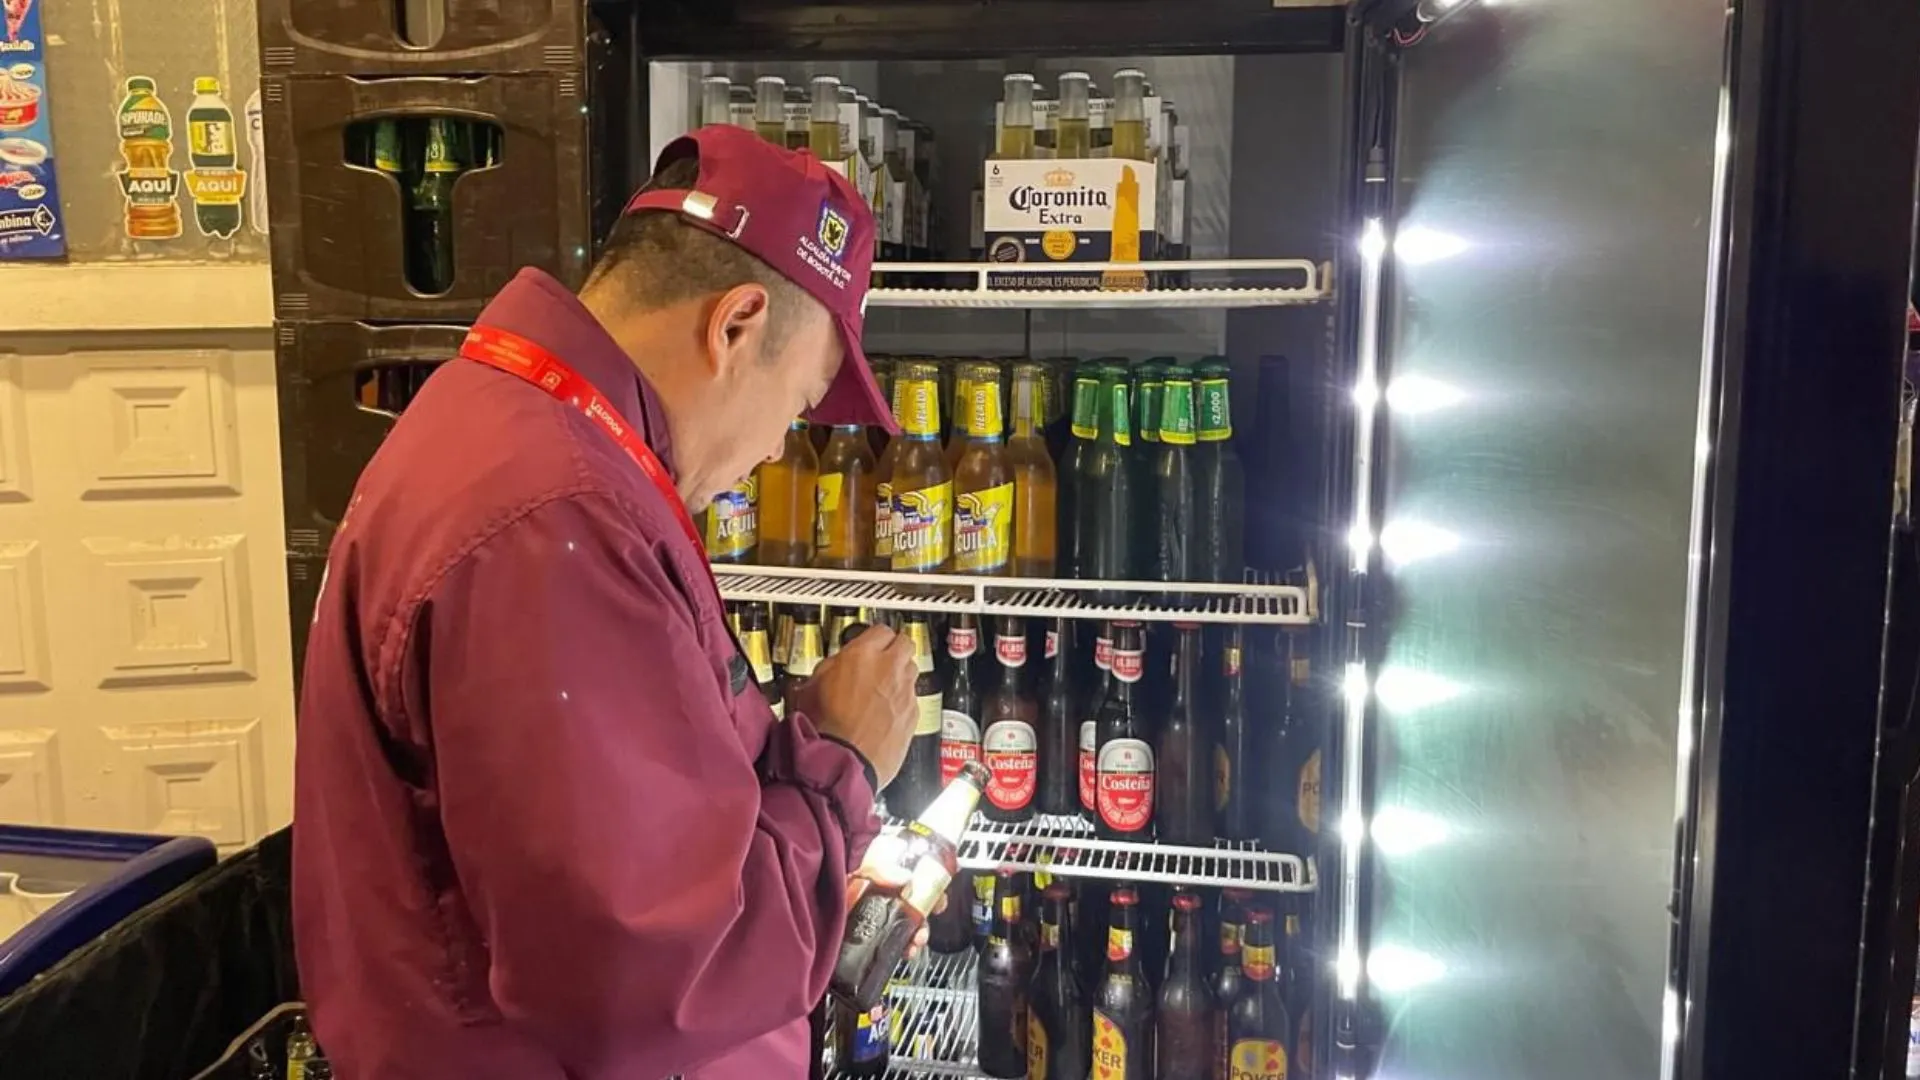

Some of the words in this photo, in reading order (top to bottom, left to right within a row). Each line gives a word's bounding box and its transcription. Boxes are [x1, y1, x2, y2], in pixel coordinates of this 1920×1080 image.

[992, 164, 1000, 175] 6
[128, 177, 171, 193] AQUÍ
[196, 179, 237, 192] AQUÍ
[1009, 186, 1107, 213] Coronita
[1039, 208, 1082, 224] Extra
[796, 246, 808, 260] DE
[1026, 276, 1053, 287] ALCOHOL
[975, 390, 986, 430] HELADA
[717, 511, 757, 538] AGUIL
[893, 526, 943, 551] AGUILA
[988, 756, 1034, 770] Costeña
[1102, 775, 1151, 790] Costeña
